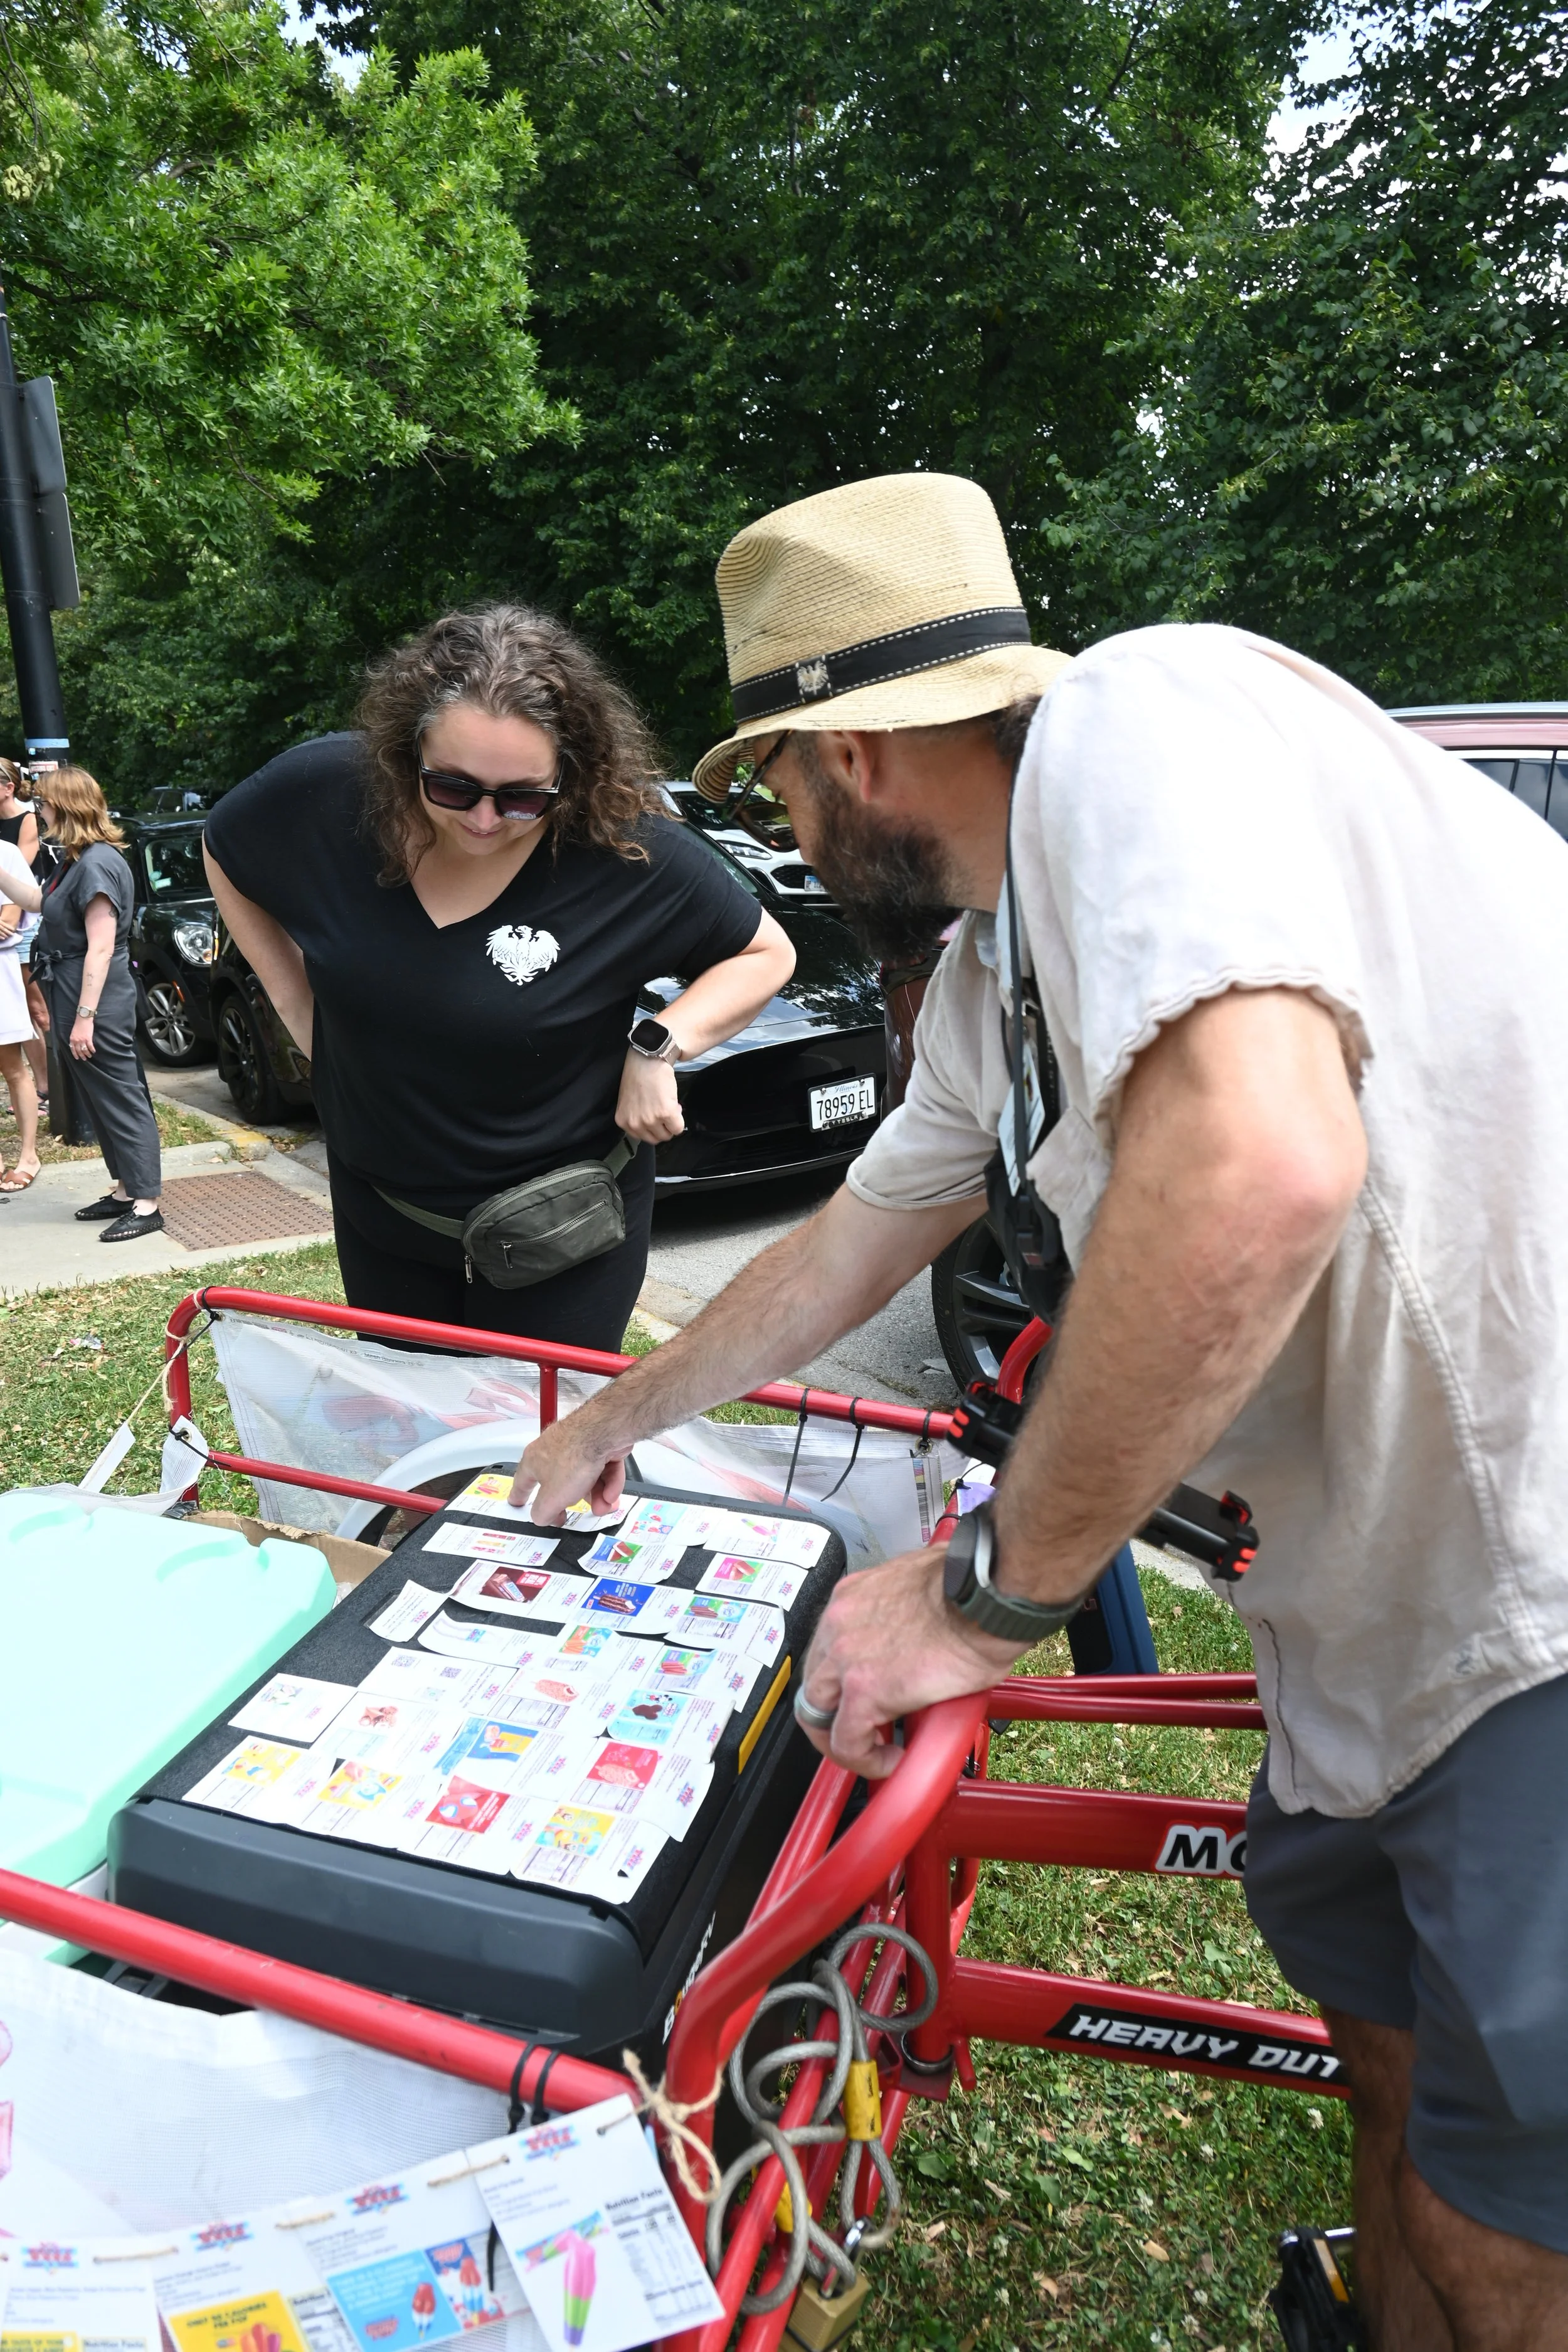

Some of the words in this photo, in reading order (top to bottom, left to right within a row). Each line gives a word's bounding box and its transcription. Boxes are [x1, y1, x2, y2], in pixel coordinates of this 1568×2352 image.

[834, 1083, 858, 1093] Illinois
[817, 1093, 855, 1120] 78959
[859, 1089, 874, 1110] EL
[837, 1115, 859, 1124] TESLA
[1069, 2014, 1239, 2059] HEAVY
[1248, 2044, 1340, 2078] DUT
